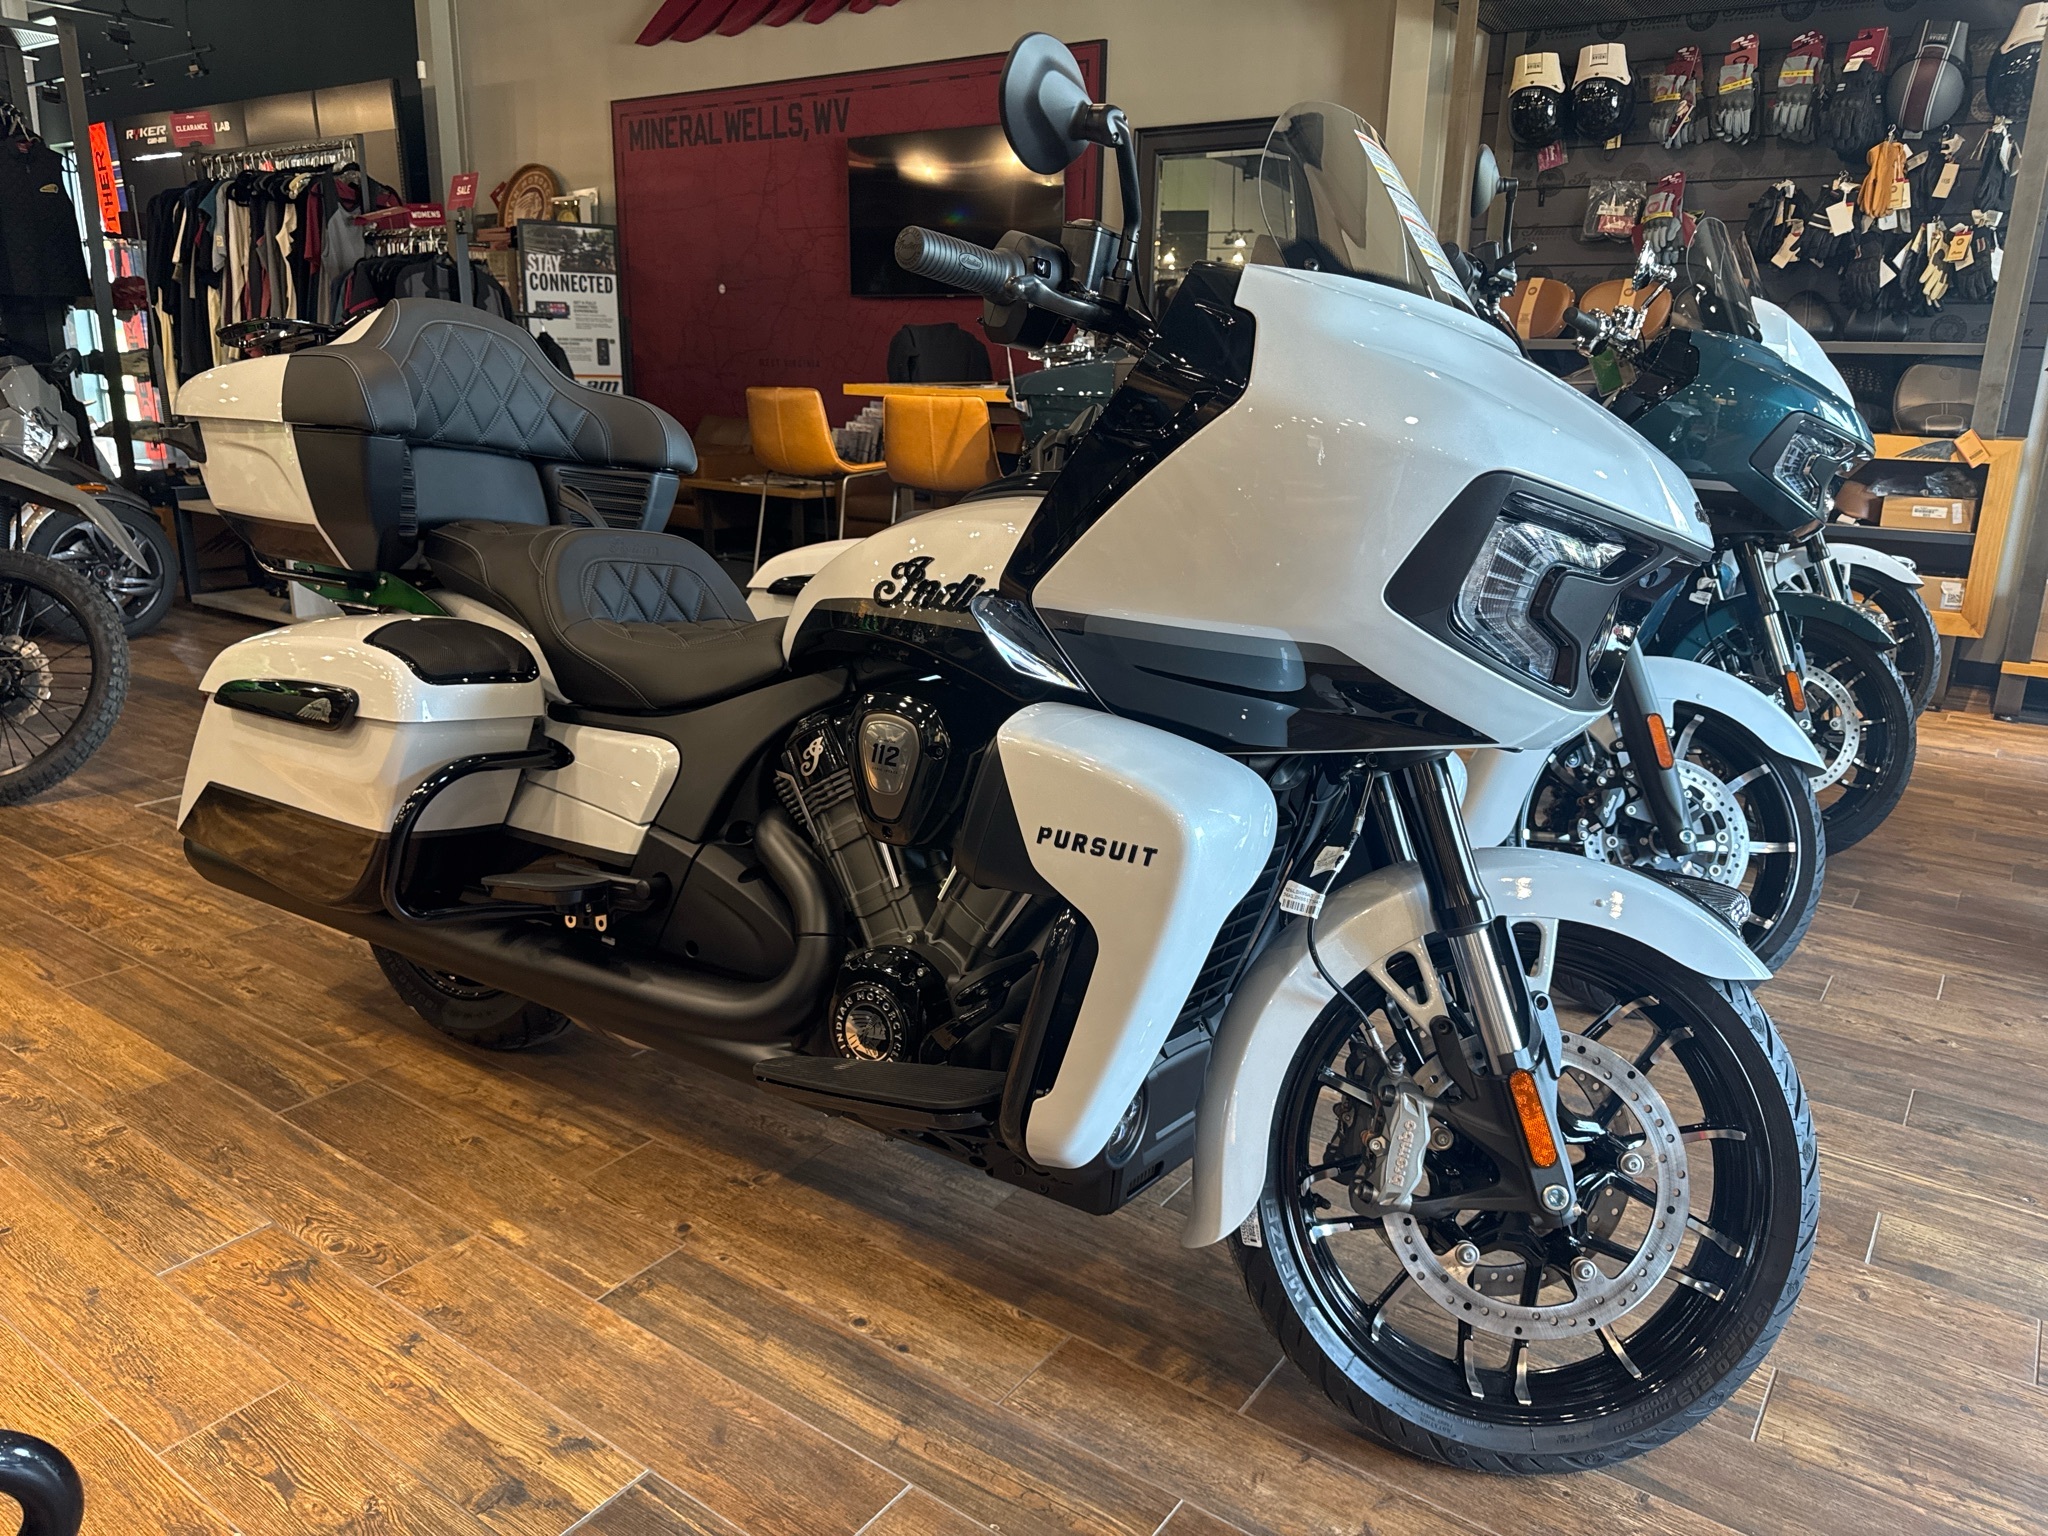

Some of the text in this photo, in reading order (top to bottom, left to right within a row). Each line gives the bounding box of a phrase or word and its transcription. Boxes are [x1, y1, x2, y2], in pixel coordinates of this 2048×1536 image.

[126, 121, 230, 140] RYKER LAB
[175, 122, 208, 132] CLEARANCE
[629, 98, 849, 151] MINERAL WELLS, WV
[456, 184, 471, 196] SALE
[411, 210, 441, 219] WOMENS
[527, 254, 561, 272] STAY
[529, 272, 614, 294] CONNECTED
[873, 556, 1000, 614] Indi
[871, 743, 900, 768] 112
[1036, 826, 1158, 867] PURSUIT
[836, 996, 854, 1050] INDIAN
[1389, 1119, 1417, 1187] brembo
